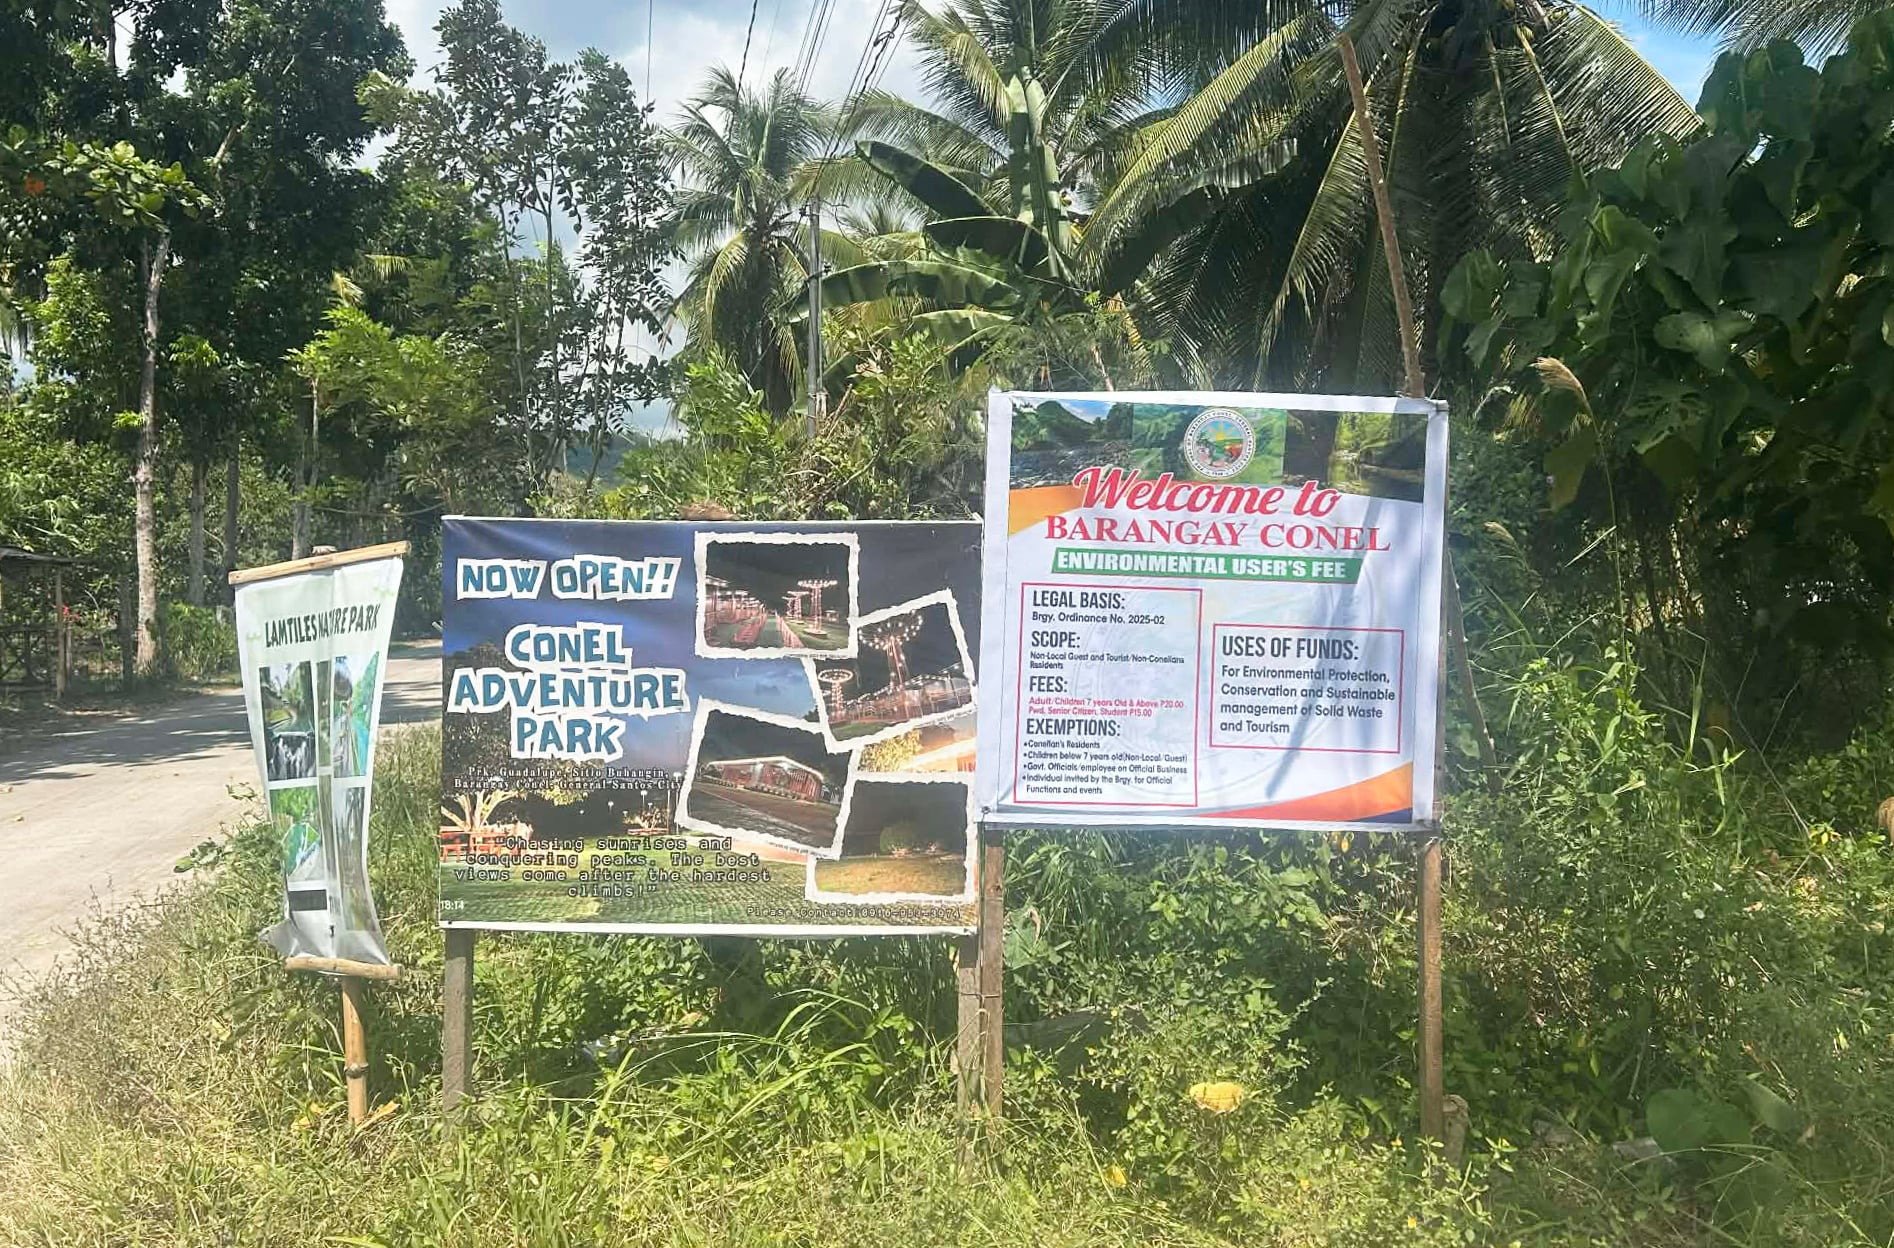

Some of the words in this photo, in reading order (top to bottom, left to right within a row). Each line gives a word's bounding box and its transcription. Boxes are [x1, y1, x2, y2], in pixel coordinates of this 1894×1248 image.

[1073, 466, 1285, 515] Welcome
[1293, 479, 1341, 518] to
[1044, 515, 1248, 547] BARANGAY
[1260, 523, 1390, 551] CONEL
[1057, 551, 1227, 576] ENVIRONMENTAL
[1232, 558, 1308, 578] USER'S
[1311, 561, 1348, 578] FEE
[460, 562, 542, 595] NOW
[554, 558, 676, 596] OPEN!!
[1033, 590, 1077, 607] LEGAL
[1080, 592, 1126, 609] BASIS:
[264, 613, 318, 648] LAMTILES
[348, 603, 381, 634] PARK
[1032, 612, 1055, 623] Brgy.
[1058, 613, 1107, 624] Ordinance
[1110, 614, 1126, 624] No.
[1128, 615, 1165, 625] 2025-02
[509, 626, 628, 665] CONEL
[1031, 631, 1081, 649] SCOPE:
[1222, 636, 1266, 657] USES
[1271, 637, 1292, 658] OF
[1296, 638, 1359, 660] FUNDS:
[1030, 651, 1066, 661] Non-Local
[1068, 652, 1089, 661] Guest
[1090, 654, 1105, 662] and
[1030, 661, 1064, 670] Residents
[1221, 665, 1240, 678] For
[1243, 665, 1325, 680] Environmental
[1328, 668, 1391, 684] Protection,
[452, 671, 686, 711] ADVENTURE
[1029, 676, 1068, 693] FEES:
[1221, 683, 1297, 698] Conservation
[1300, 686, 1323, 698] and
[1326, 686, 1395, 701] Sustainable
[1087, 698, 1092, 707] 7
[1093, 699, 1113, 708] years
[1114, 700, 1127, 708] Old
[1128, 700, 1135, 708] &
[1136, 700, 1159, 709] Above
[1220, 703, 1298, 717] management
[1300, 703, 1312, 716] of
[1315, 704, 1344, 718] Solid
[1347, 706, 1383, 719] Waste
[1048, 707, 1070, 716] Senior
[1100, 708, 1128, 717] Student
[1026, 718, 1121, 737] EXEMPTIONS:
[1220, 720, 1242, 732] and
[1246, 719, 1290, 733] Tourism
[515, 715, 622, 757] PARK
[1066, 741, 1101, 749] Residents
[1027, 751, 1058, 760] Children
[1059, 752, 1082, 760] below
[1089, 754, 1110, 762] years
[572, 767, 602, 778] Sitio
[606, 767, 669, 780] Buhangin,
[1027, 762, 1046, 772] Govt.
[1117, 765, 1127, 773] on
[1128, 764, 1155, 773] Official
[1156, 765, 1188, 775] Business
[453, 778, 510, 791] Barangay
[559, 780, 606, 789] General
[611, 780, 653, 790] Santos
[657, 780, 682, 791] City
[1026, 774, 1063, 783] Individual
[1064, 775, 1091, 783] invited
[1091, 776, 1100, 785] by
[1102, 776, 1114, 784] the
[1134, 776, 1145, 784] for
[1146, 776, 1173, 785] Official
[1026, 785, 1062, 794] Functions
[1063, 786, 1078, 794] and
[1079, 786, 1103, 795] events
[597, 837, 687, 850] sunrises
[700, 837, 732, 850] and
[466, 853, 579, 868] conquering
[590, 853, 656, 868] peaks.
[671, 852, 704, 866] The
[716, 853, 760, 867] best
[454, 868, 510, 881] views
[523, 869, 567, 881] come
[579, 869, 635, 882] after
[649, 868, 681, 882] the
[692, 868, 772, 882] hardest
[440, 901, 464, 911] 18:14
[747, 907, 792, 917] Please
[800, 908, 853, 918] Contact
